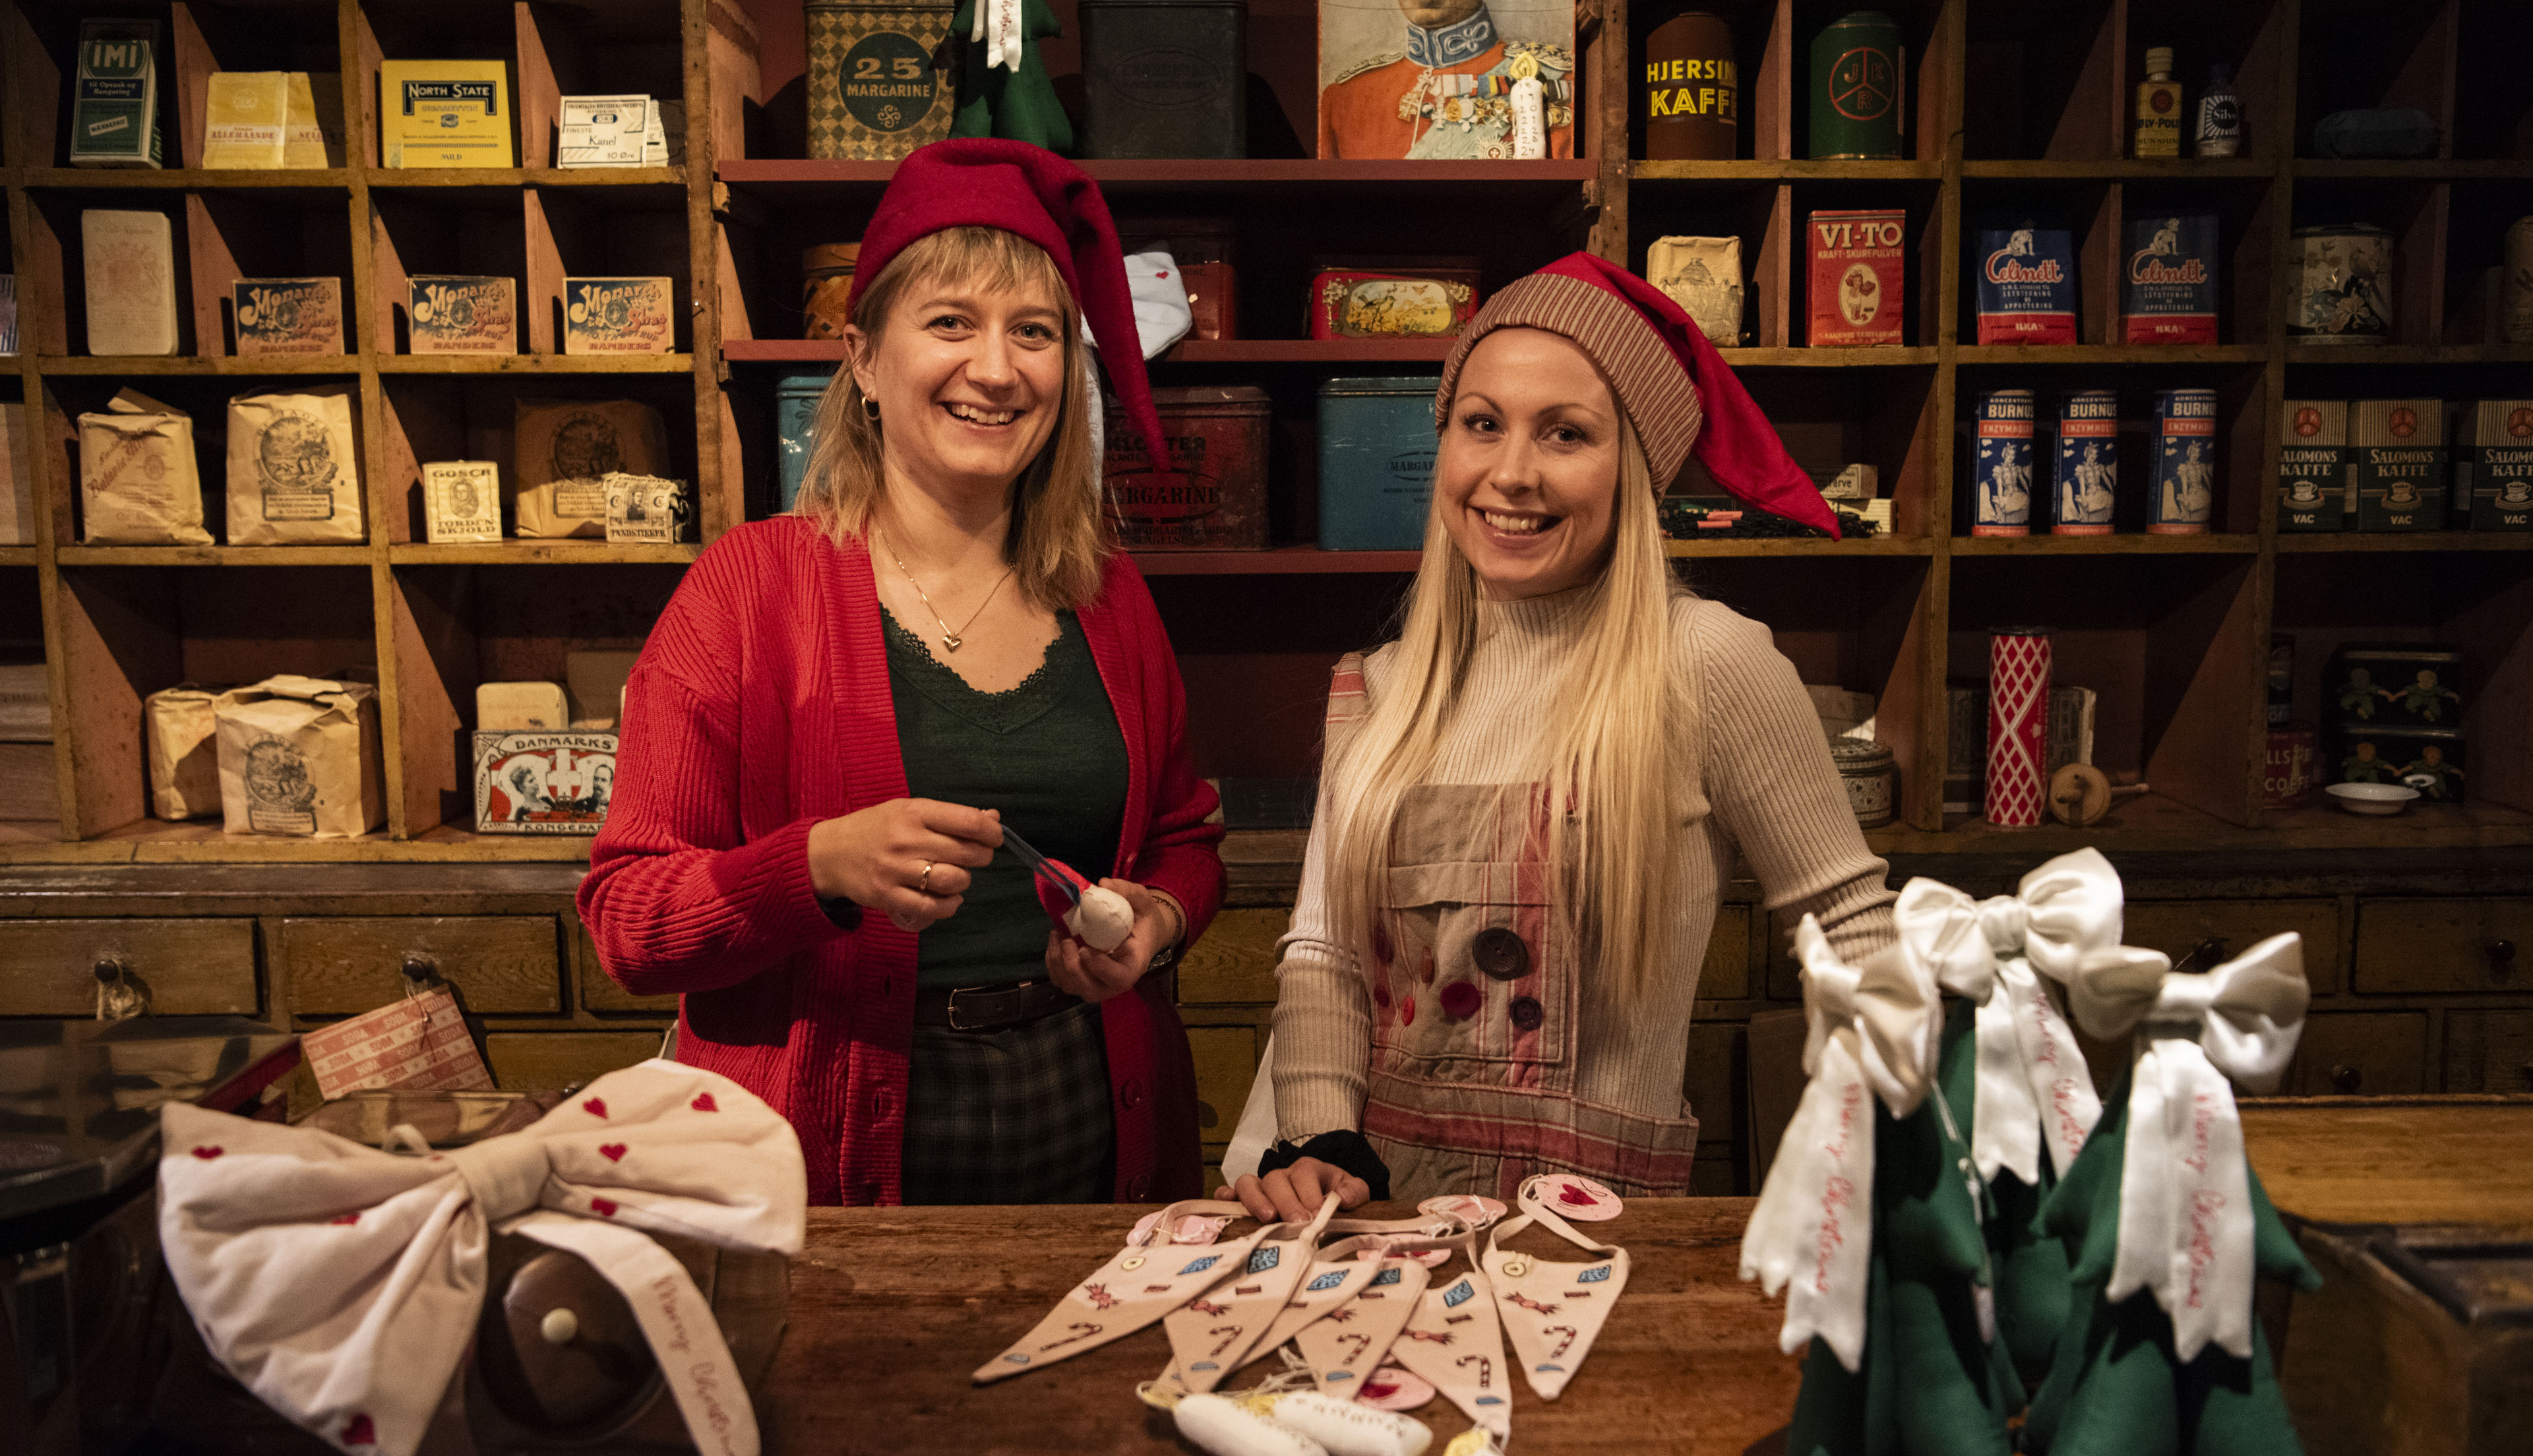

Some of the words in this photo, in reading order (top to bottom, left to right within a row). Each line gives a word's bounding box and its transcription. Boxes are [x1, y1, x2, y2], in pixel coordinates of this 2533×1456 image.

[853, 57, 923, 80] 25
[408, 83, 448, 98] NORTH
[452, 83, 490, 98] STATE
[847, 84, 931, 97] MARGARINE
[589, 135, 617, 146] Kanel
[1817, 222, 1904, 249] VI-TO
[2173, 402, 2216, 417] BURNU
[1107, 437, 1206, 451] KLOTER
[2280, 450, 2337, 462] ALOMONS
[2370, 448, 2434, 464] SALOMONS
[2280, 464, 2332, 476] KAFFE
[2378, 464, 2427, 477] KAFFE
[2292, 514, 2315, 525] VAC
[2391, 514, 2412, 526] VAC
[2504, 514, 2527, 525] VAC
[515, 737, 612, 750] DANMARKS
[439, 1026, 462, 1042] SODA
[369, 1036, 395, 1052] SODA
[328, 1052, 354, 1066] SODA
[452, 1056, 477, 1072] SODA
[356, 1059, 381, 1074] SODA
[382, 1065, 409, 1081] SODA
